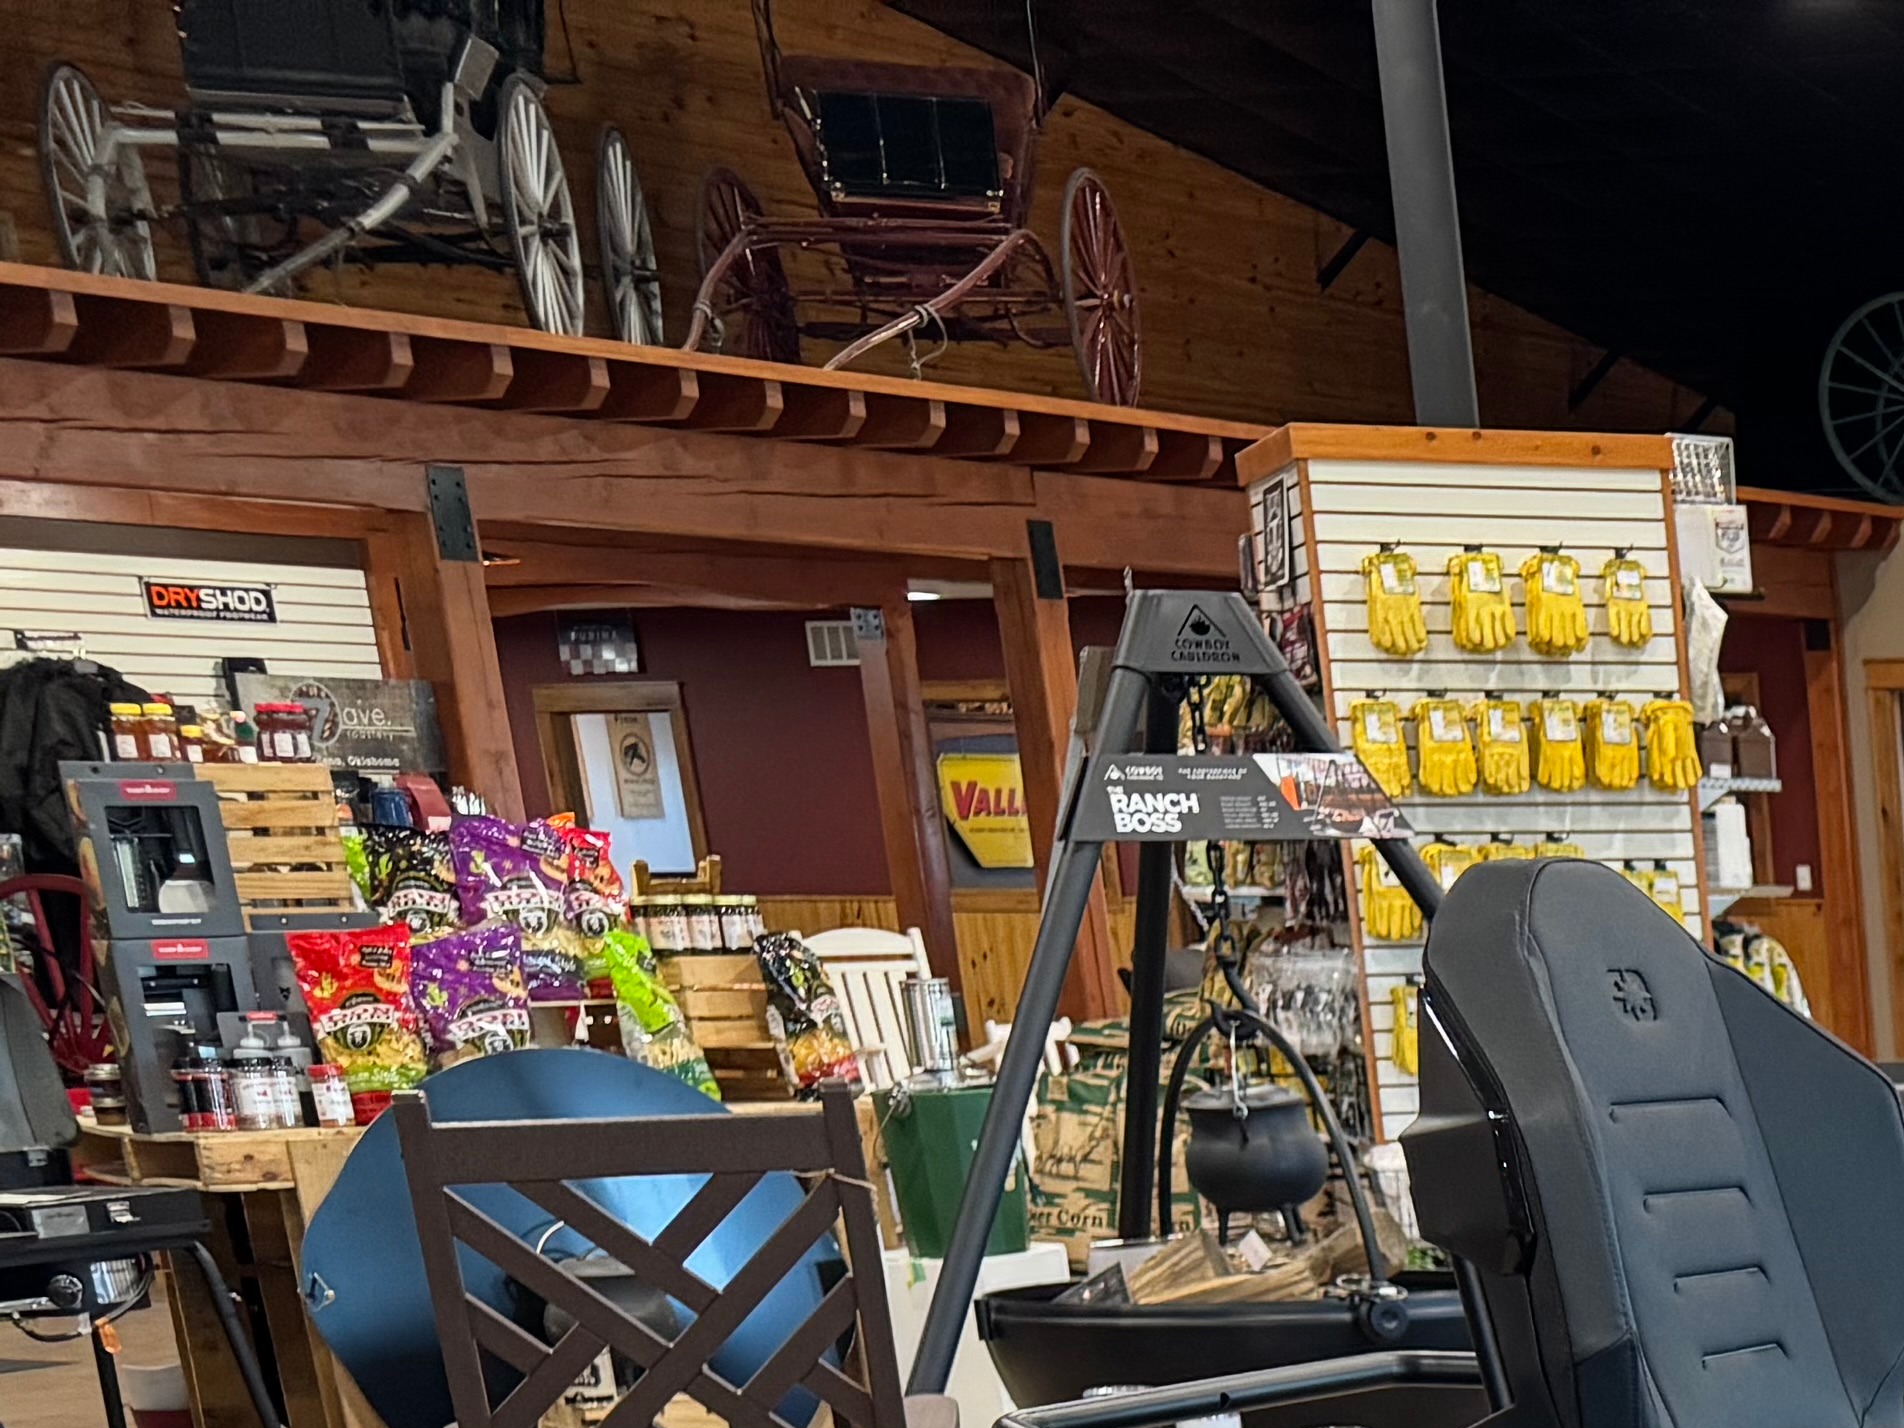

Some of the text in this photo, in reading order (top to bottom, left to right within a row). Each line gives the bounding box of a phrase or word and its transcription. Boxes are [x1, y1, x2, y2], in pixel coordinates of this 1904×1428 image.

[150, 585, 268, 612] DRYSHOD
[1110, 793, 1200, 814] RANCH
[1114, 812, 1182, 833] BOSS
